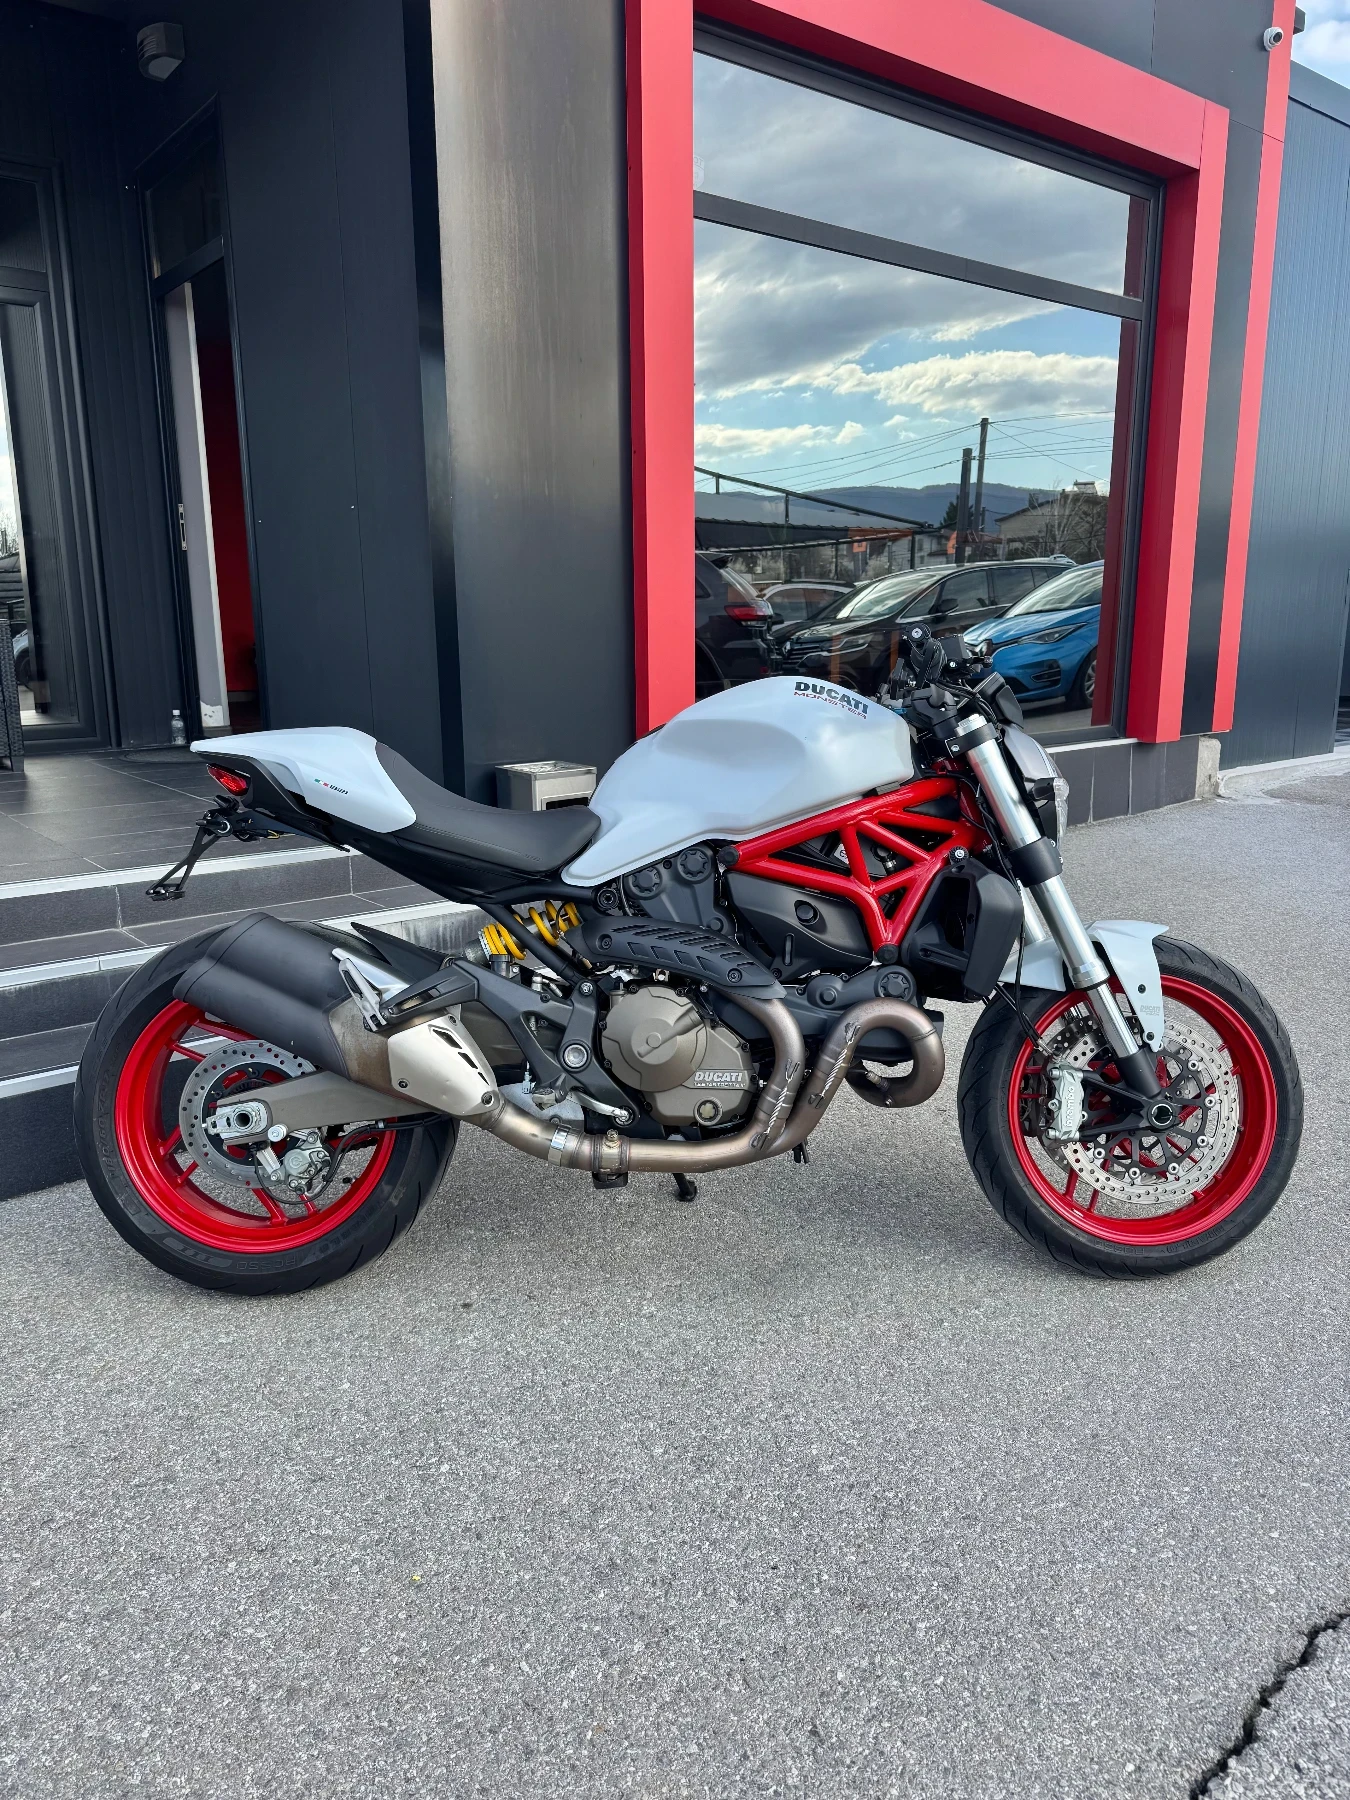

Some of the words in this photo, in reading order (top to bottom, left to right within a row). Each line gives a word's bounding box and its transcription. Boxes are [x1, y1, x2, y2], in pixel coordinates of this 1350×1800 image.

[793, 691, 867, 720] MONSTER
[795, 681, 869, 715] DUCATI
[694, 1071, 743, 1082] DUCATI
[1063, 1086, 1075, 1128] brembo
